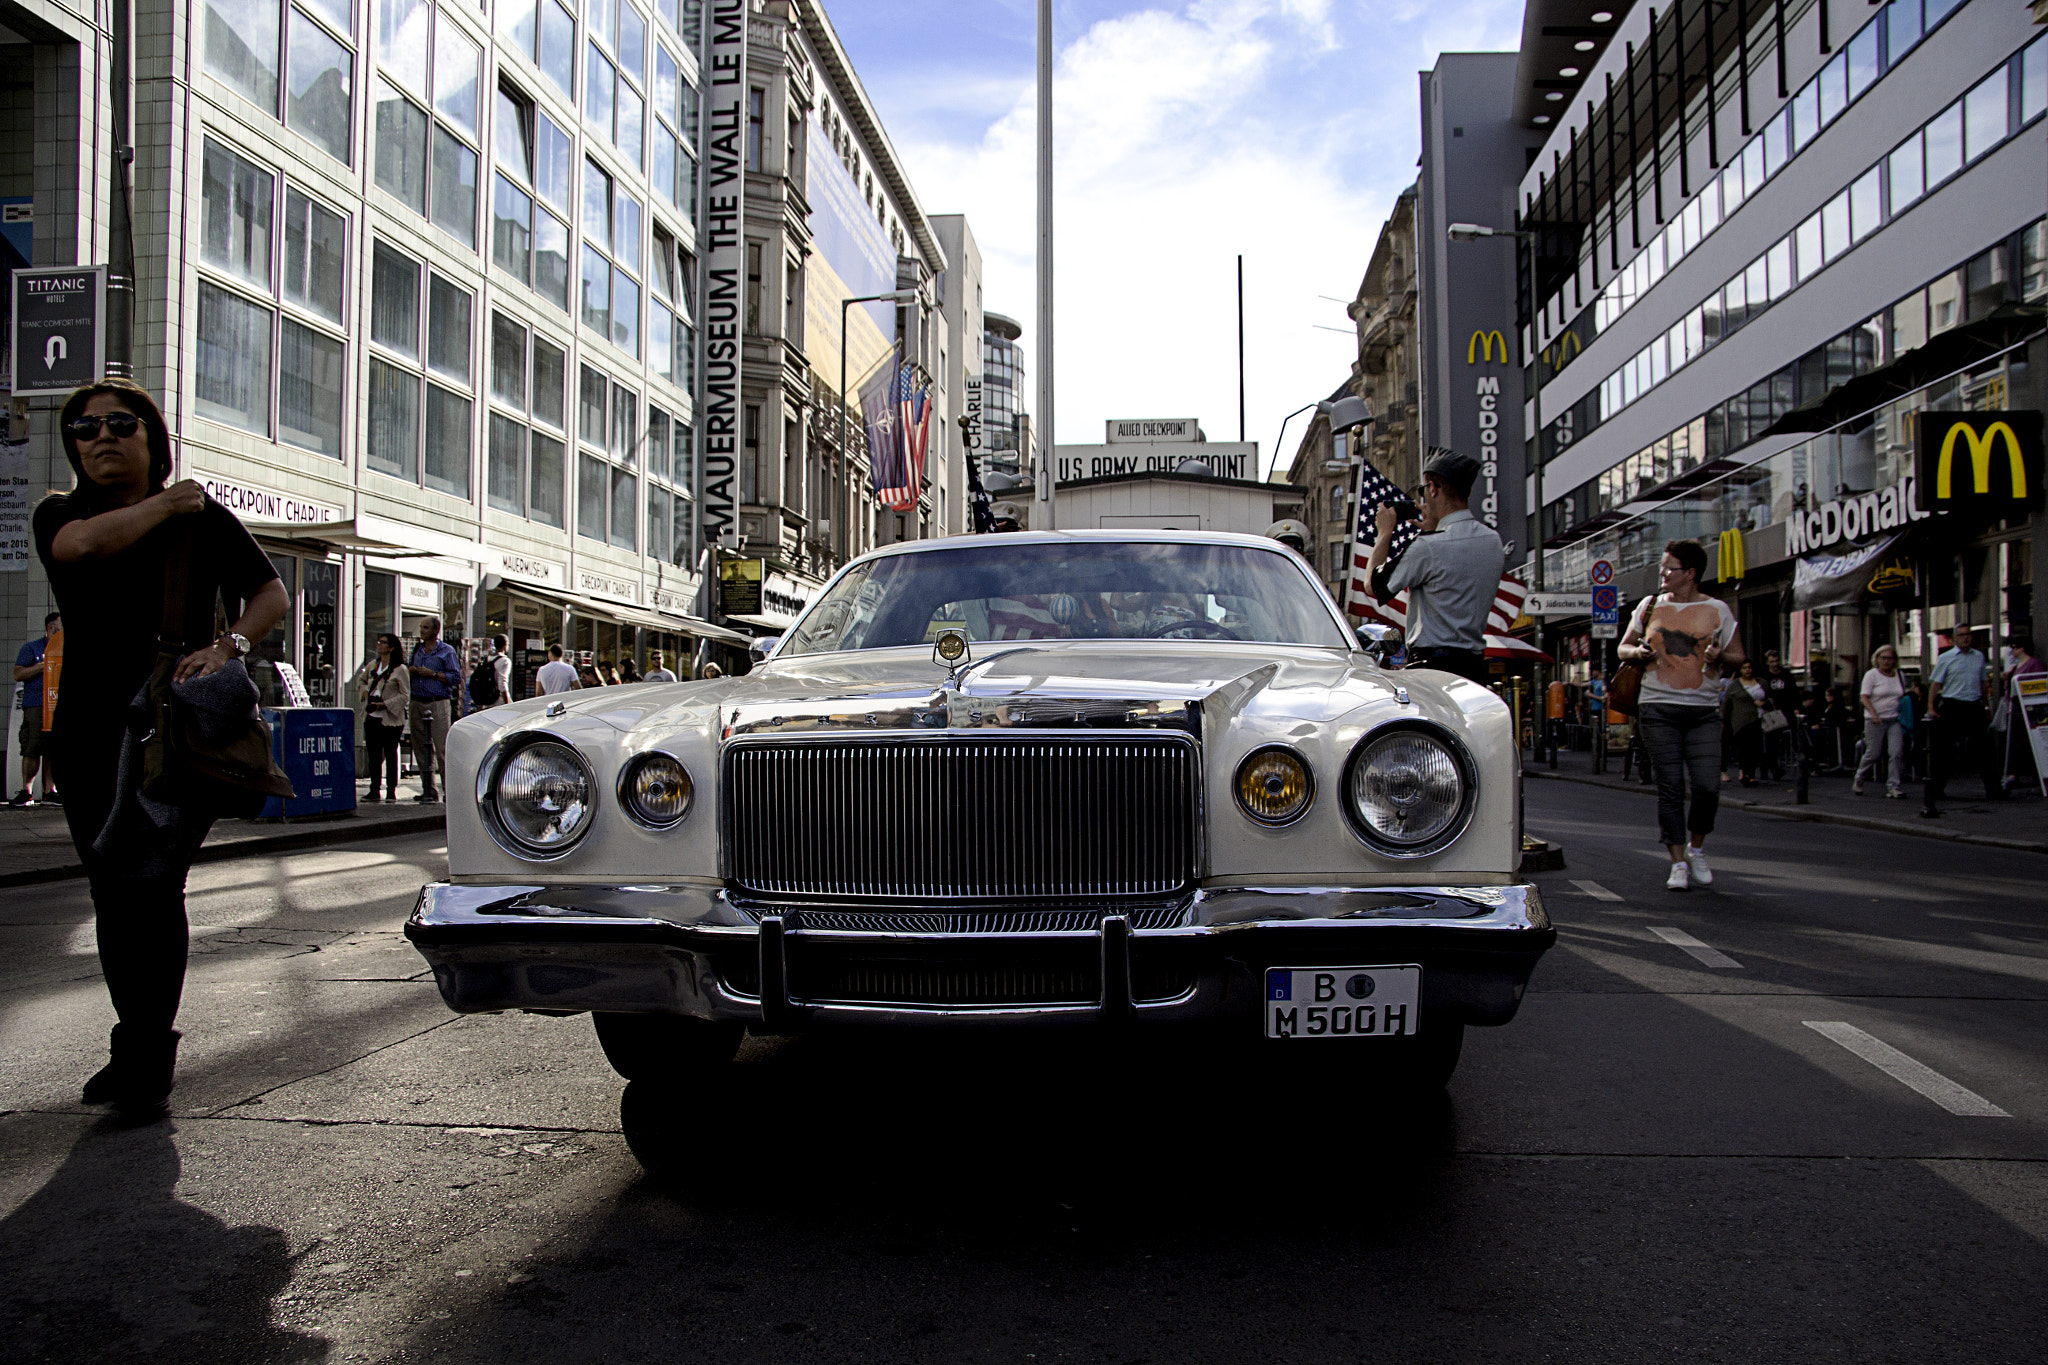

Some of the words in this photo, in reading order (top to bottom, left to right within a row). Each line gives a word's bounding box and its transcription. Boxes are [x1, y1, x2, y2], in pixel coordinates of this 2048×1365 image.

[712, 54, 740, 86] LE
[710, 101, 739, 187] WALL
[708, 196, 738, 252] THE
[27, 278, 86, 292] TITANIC
[46, 294, 65, 303] HOTELS
[21, 320, 43, 328] TITANIC
[43, 319, 74, 328] COMFORT
[75, 317, 92, 326] MITTE
[705, 268, 737, 535] MAUERMUSEUM
[968, 380, 981, 449] CHARLIE
[1118, 422, 1140, 437] ALLIED
[1143, 422, 1187, 436] CHECKPOINT
[1477, 376, 1500, 529] McDonalds
[1091, 456, 1138, 477] ARMY
[206, 480, 281, 518] CHECKPOINT
[10, 539, 28, 549] 2015
[502, 554, 549, 580] MAUERMUSEUM
[410, 586, 429, 598] MUSEUM
[580, 573, 611, 594] CHECKPOINT
[612, 580, 632, 599] CHARLIE
[1594, 611, 1616, 621] TAXI
[299, 737, 315, 754] LIFE
[317, 737, 326, 753] IN
[328, 736, 342, 752] THE
[313, 759, 330, 776] GDR
[1275, 989, 1284, 998] D
[1315, 973, 1336, 1002] B
